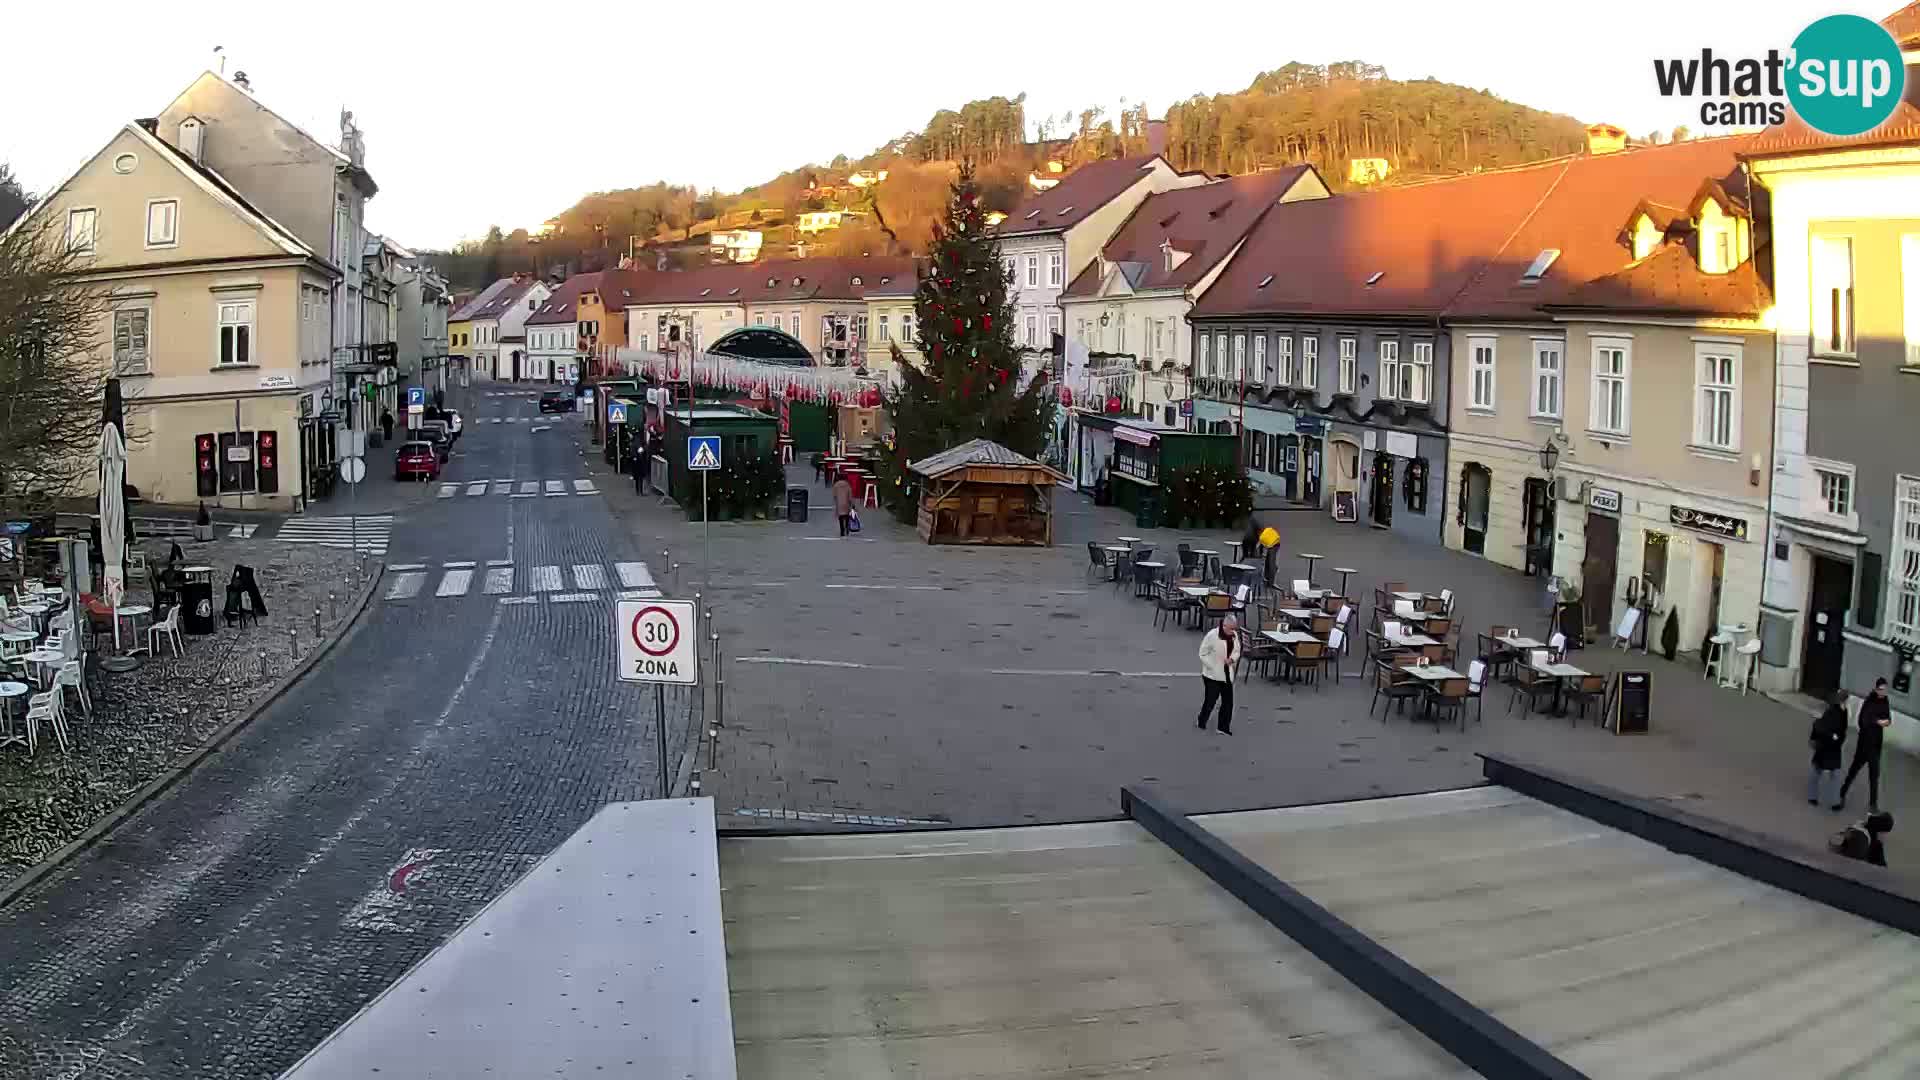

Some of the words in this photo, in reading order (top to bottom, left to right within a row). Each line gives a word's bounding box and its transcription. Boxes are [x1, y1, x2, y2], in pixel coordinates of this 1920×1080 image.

[412, 391, 420, 402] P
[645, 622, 668, 643] 30
[635, 660, 679, 676] ZONA
